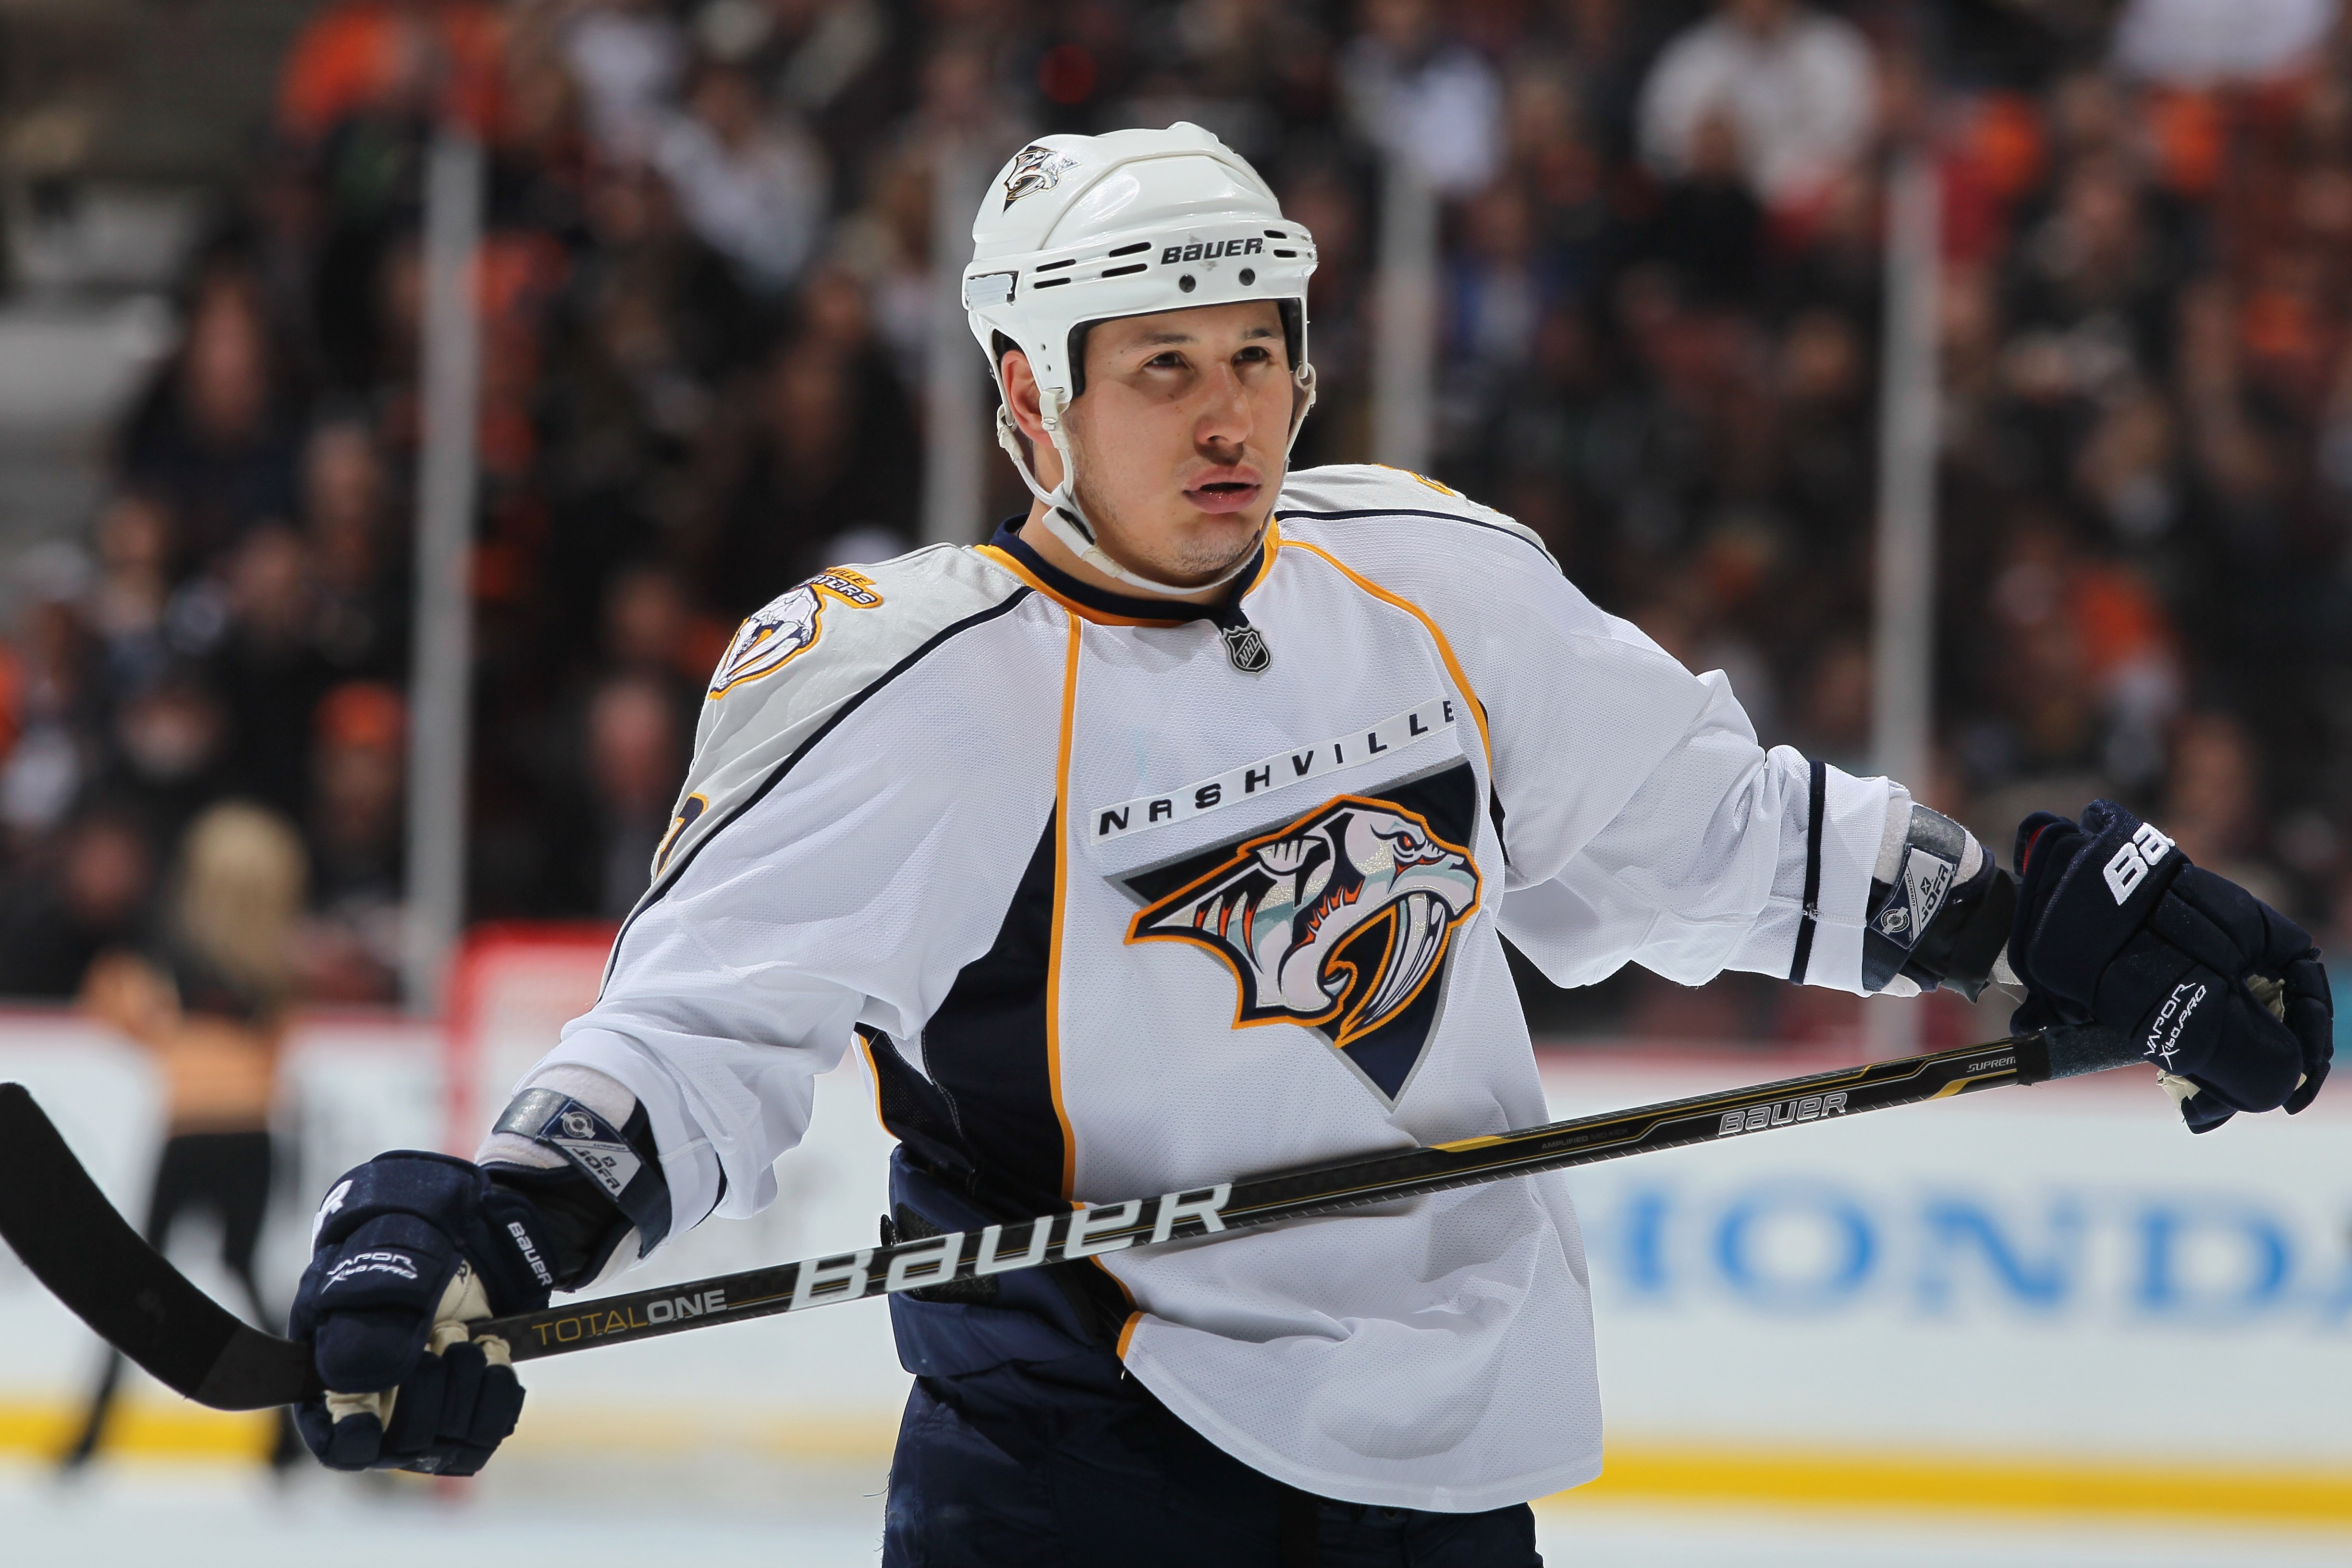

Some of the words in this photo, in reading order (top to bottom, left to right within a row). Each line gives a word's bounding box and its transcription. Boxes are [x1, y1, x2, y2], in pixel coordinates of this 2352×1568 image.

[1238, 637, 1260, 667] NHL
[1099, 700, 1454, 836] NASHVILLE
[1921, 863, 1949, 923] JOFA
[2143, 982, 2196, 1056] VAPOR
[1966, 1056, 2016, 1073] SUPREM
[1541, 1135, 1589, 1150] AMPLIFIED
[1591, 1127, 1629, 1141] MID-KICK
[572, 1148, 621, 1190] JOFA
[326, 1252, 418, 1276] VAPOR
